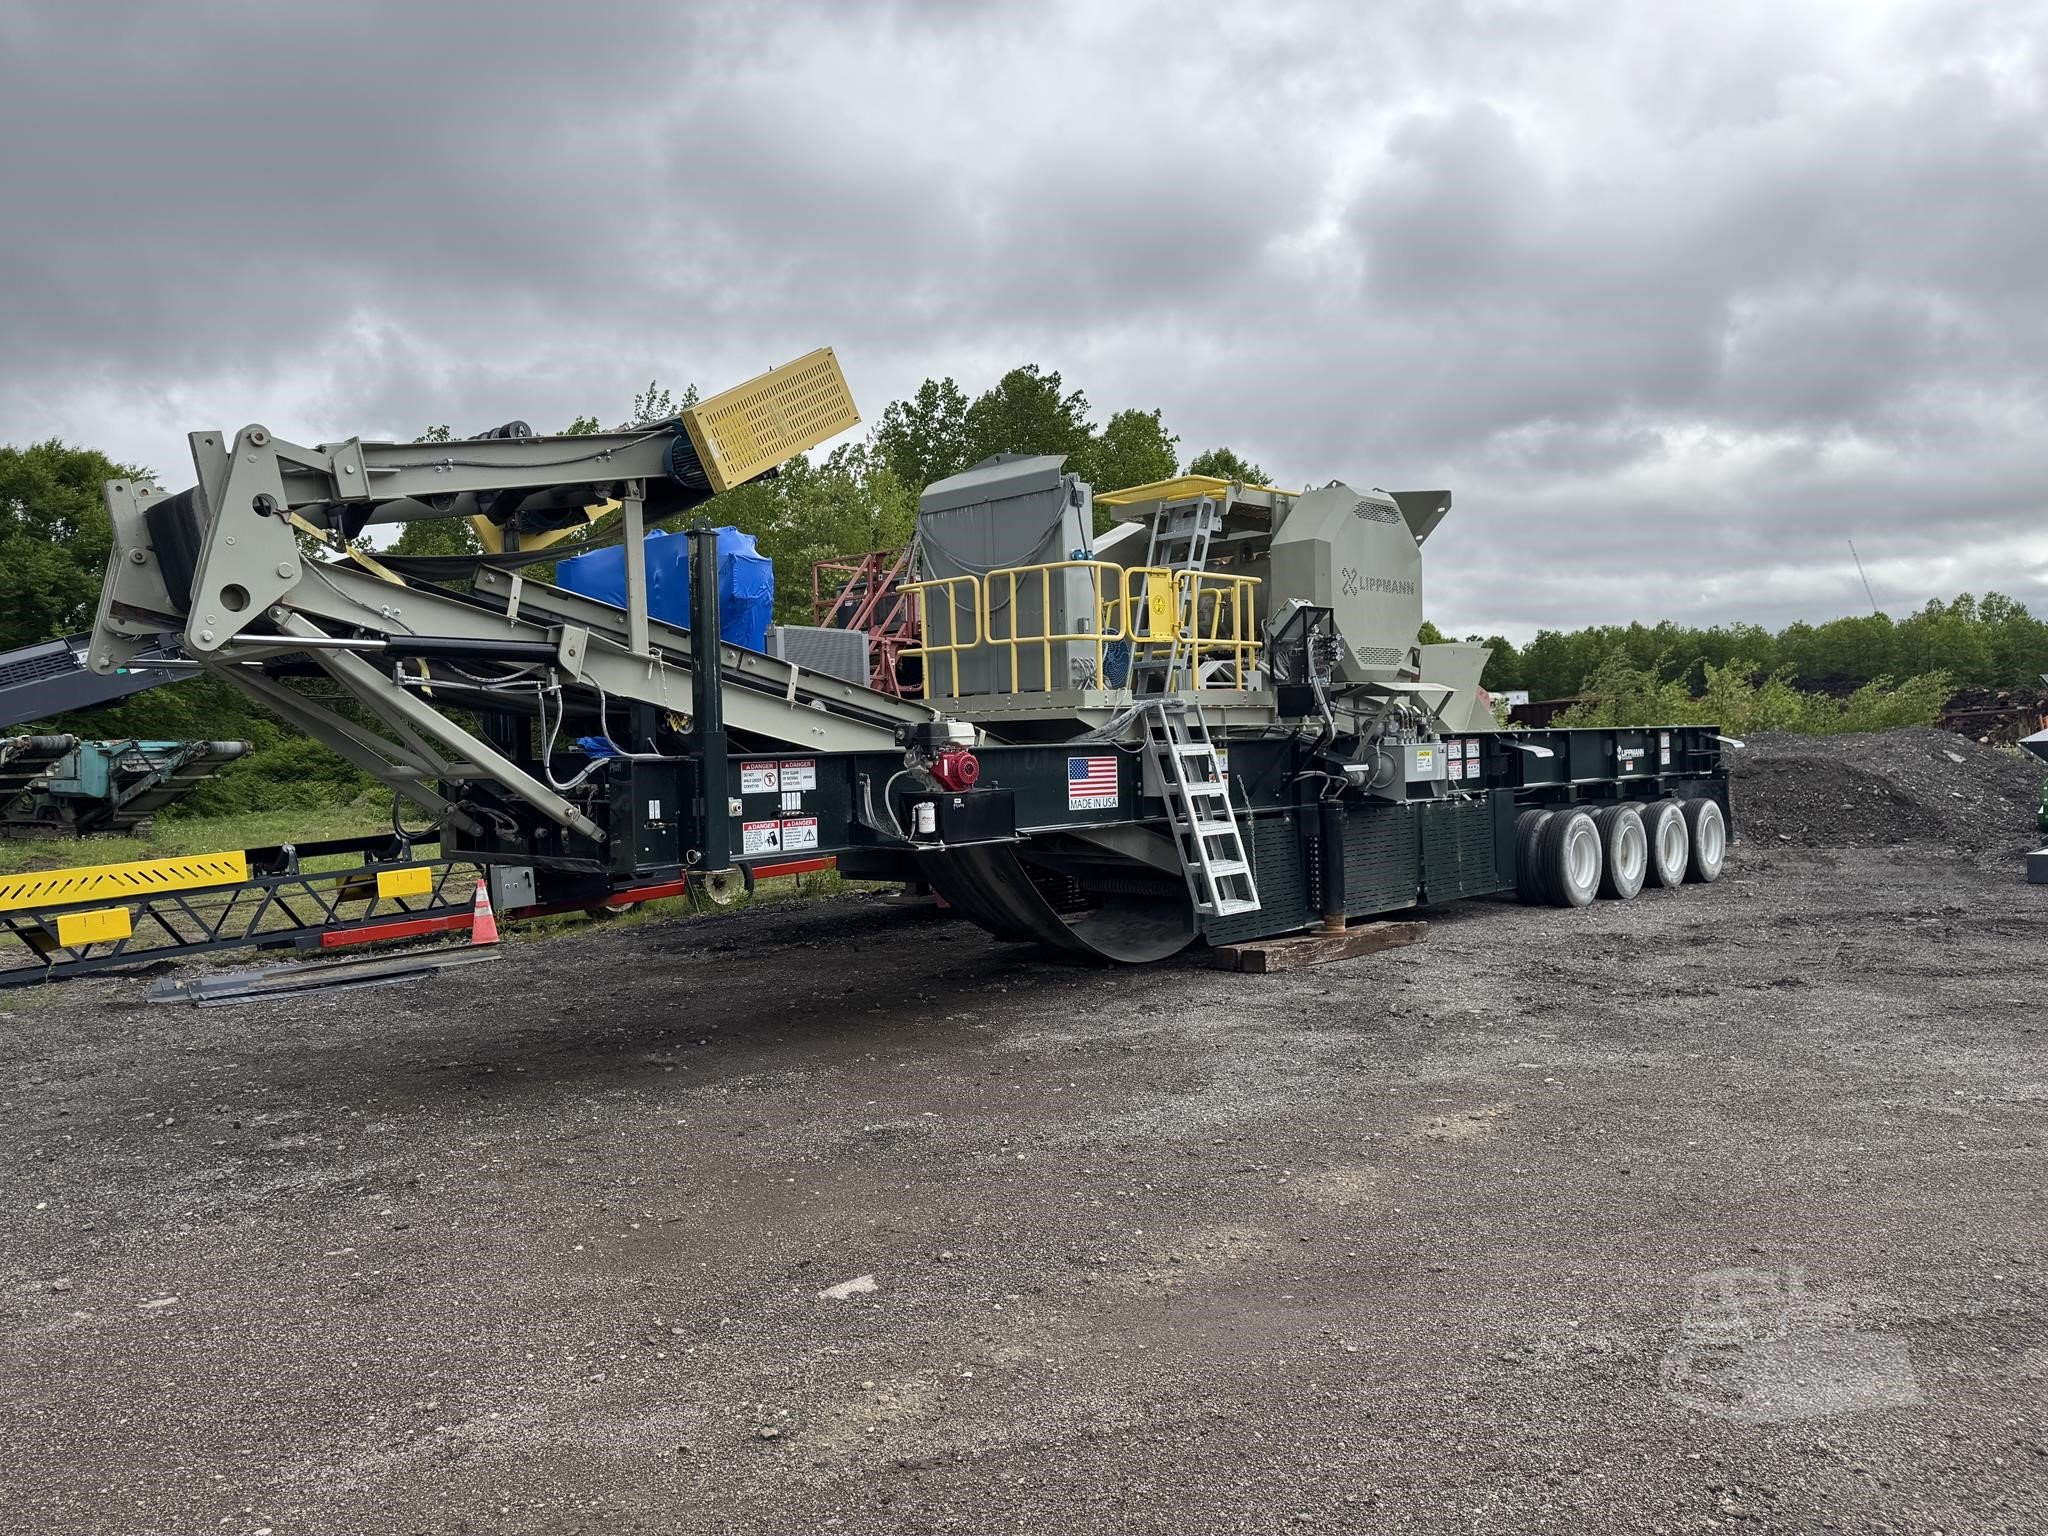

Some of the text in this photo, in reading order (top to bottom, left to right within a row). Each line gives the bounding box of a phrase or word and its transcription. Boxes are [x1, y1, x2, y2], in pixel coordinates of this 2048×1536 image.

[1360, 577, 1414, 595] LIPPMANN
[1070, 798, 1117, 809] MADE IN USA
